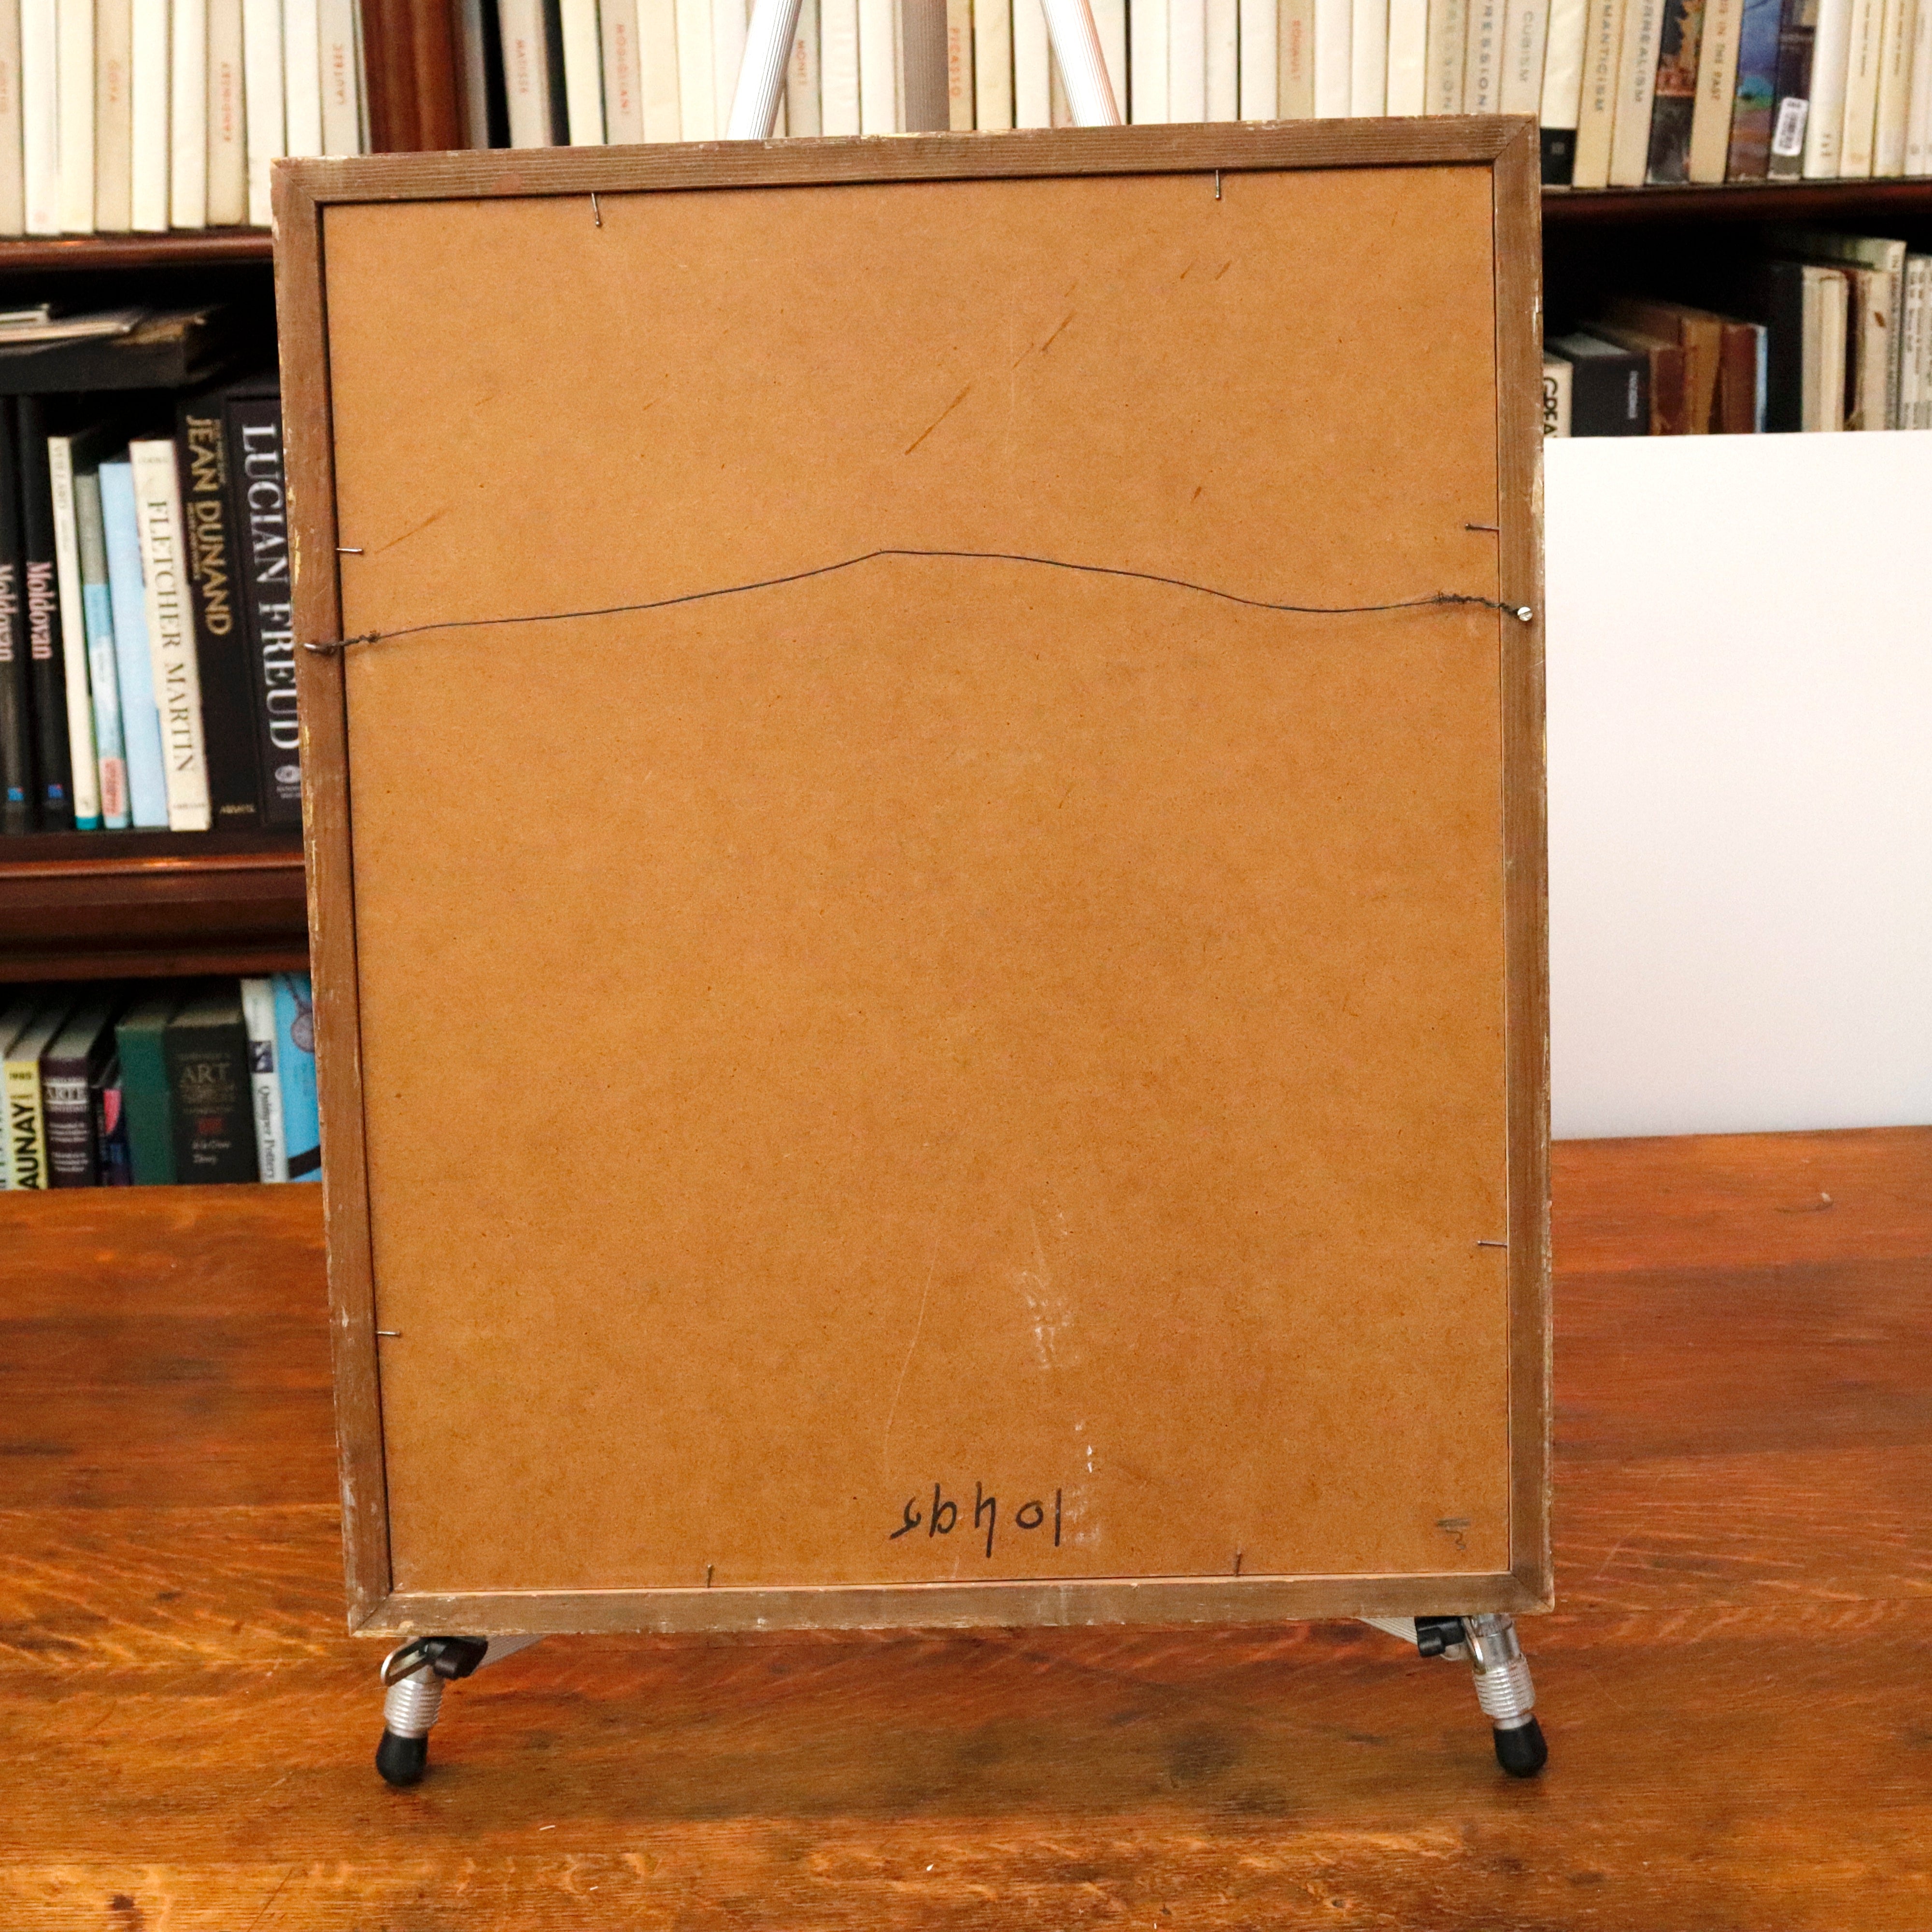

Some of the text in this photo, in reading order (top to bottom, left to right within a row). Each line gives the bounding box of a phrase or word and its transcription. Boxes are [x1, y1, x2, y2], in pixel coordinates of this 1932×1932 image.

[949, 28, 963, 99] PICASSO
[1477, 0, 1494, 114] RESSION
[1520, 10, 1534, 82] CUBISM
[1543, 377, 1559, 437] GREA
[186, 415, 234, 635] JEAN DUNAND
[242, 423, 290, 583] LUCIAN
[26, 562, 57, 660] Moldovan
[148, 501, 182, 649] FLETCHER
[165, 662, 194, 772] MARTIN
[258, 601, 300, 750] FREUD
[11, 1102, 40, 1189] AUNAY
